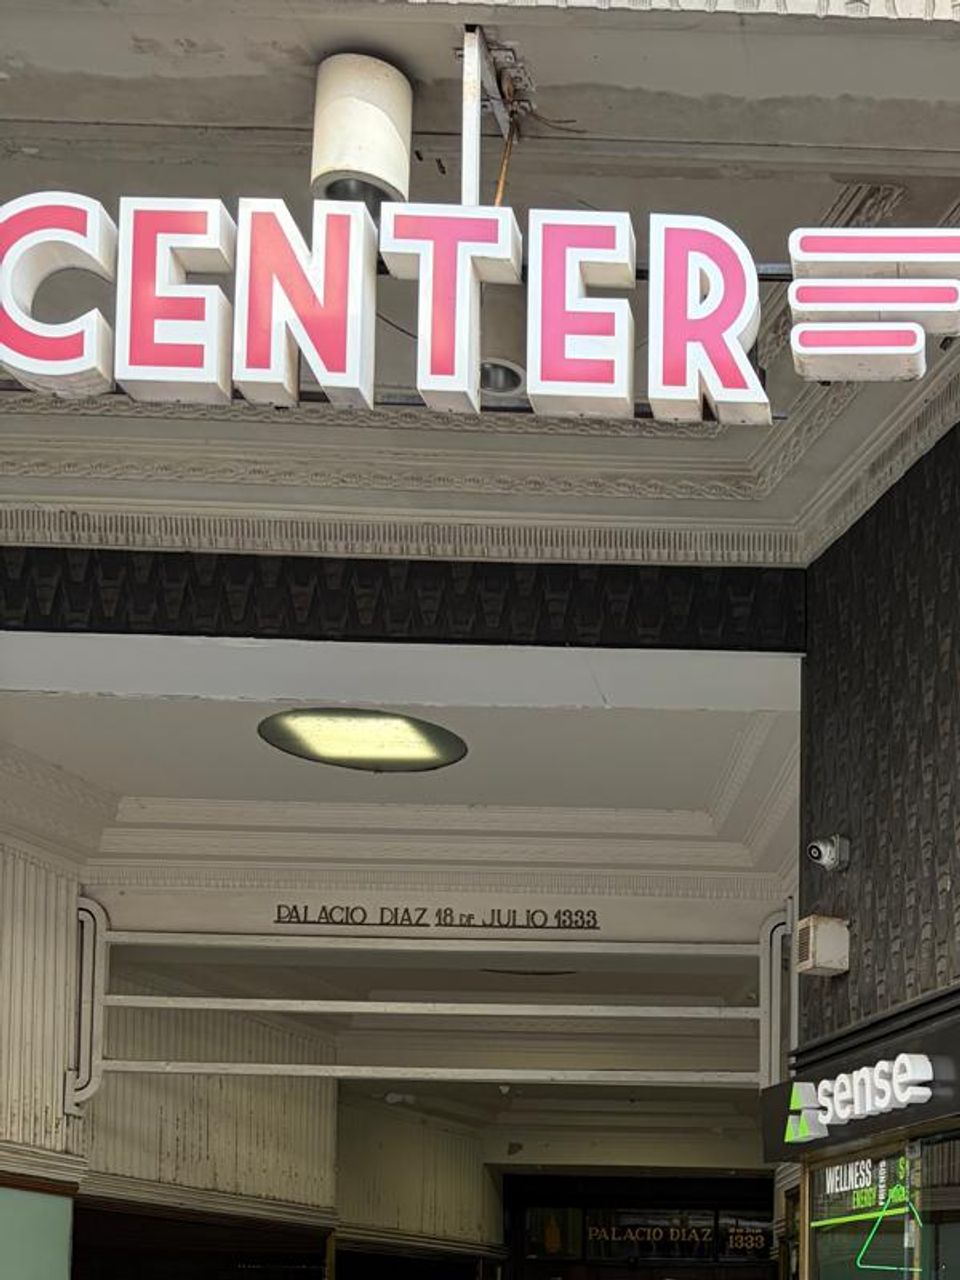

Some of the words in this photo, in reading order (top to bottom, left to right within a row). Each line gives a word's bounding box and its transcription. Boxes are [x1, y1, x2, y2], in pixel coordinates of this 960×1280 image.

[0, 191, 770, 424] CENTER
[276, 904, 368, 925] PALACIO
[380, 907, 428, 926] DIAZ
[434, 907, 455, 927] 18
[482, 908, 548, 928] JULIO
[553, 909, 599, 929] 1333
[816, 1052, 933, 1126] sense
[826, 1158, 872, 1194] WELLNESS
[588, 1226, 664, 1242] PALACIO
[670, 1227, 713, 1242] DIAZ
